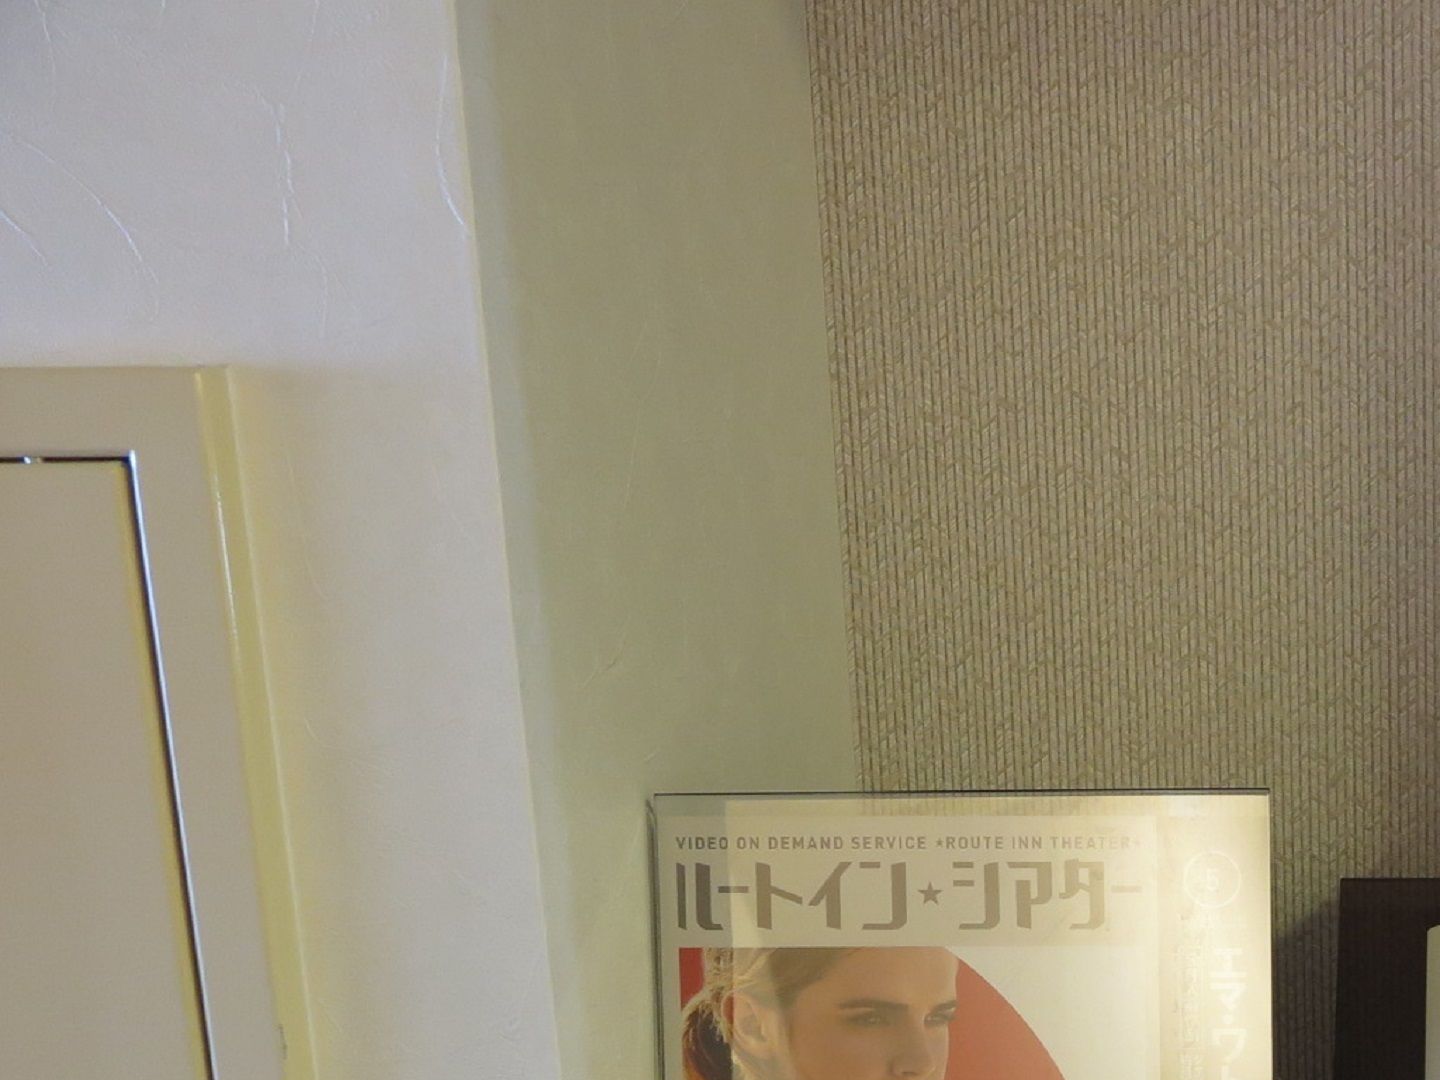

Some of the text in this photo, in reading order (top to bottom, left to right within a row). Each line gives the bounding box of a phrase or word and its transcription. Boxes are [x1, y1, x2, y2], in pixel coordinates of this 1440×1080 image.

[676, 835, 729, 850] VIDEO
[736, 836, 760, 850] ON
[768, 836, 844, 850] DEMAND
[851, 836, 926, 850] SERVICE
[1011, 836, 1042, 850] INN
